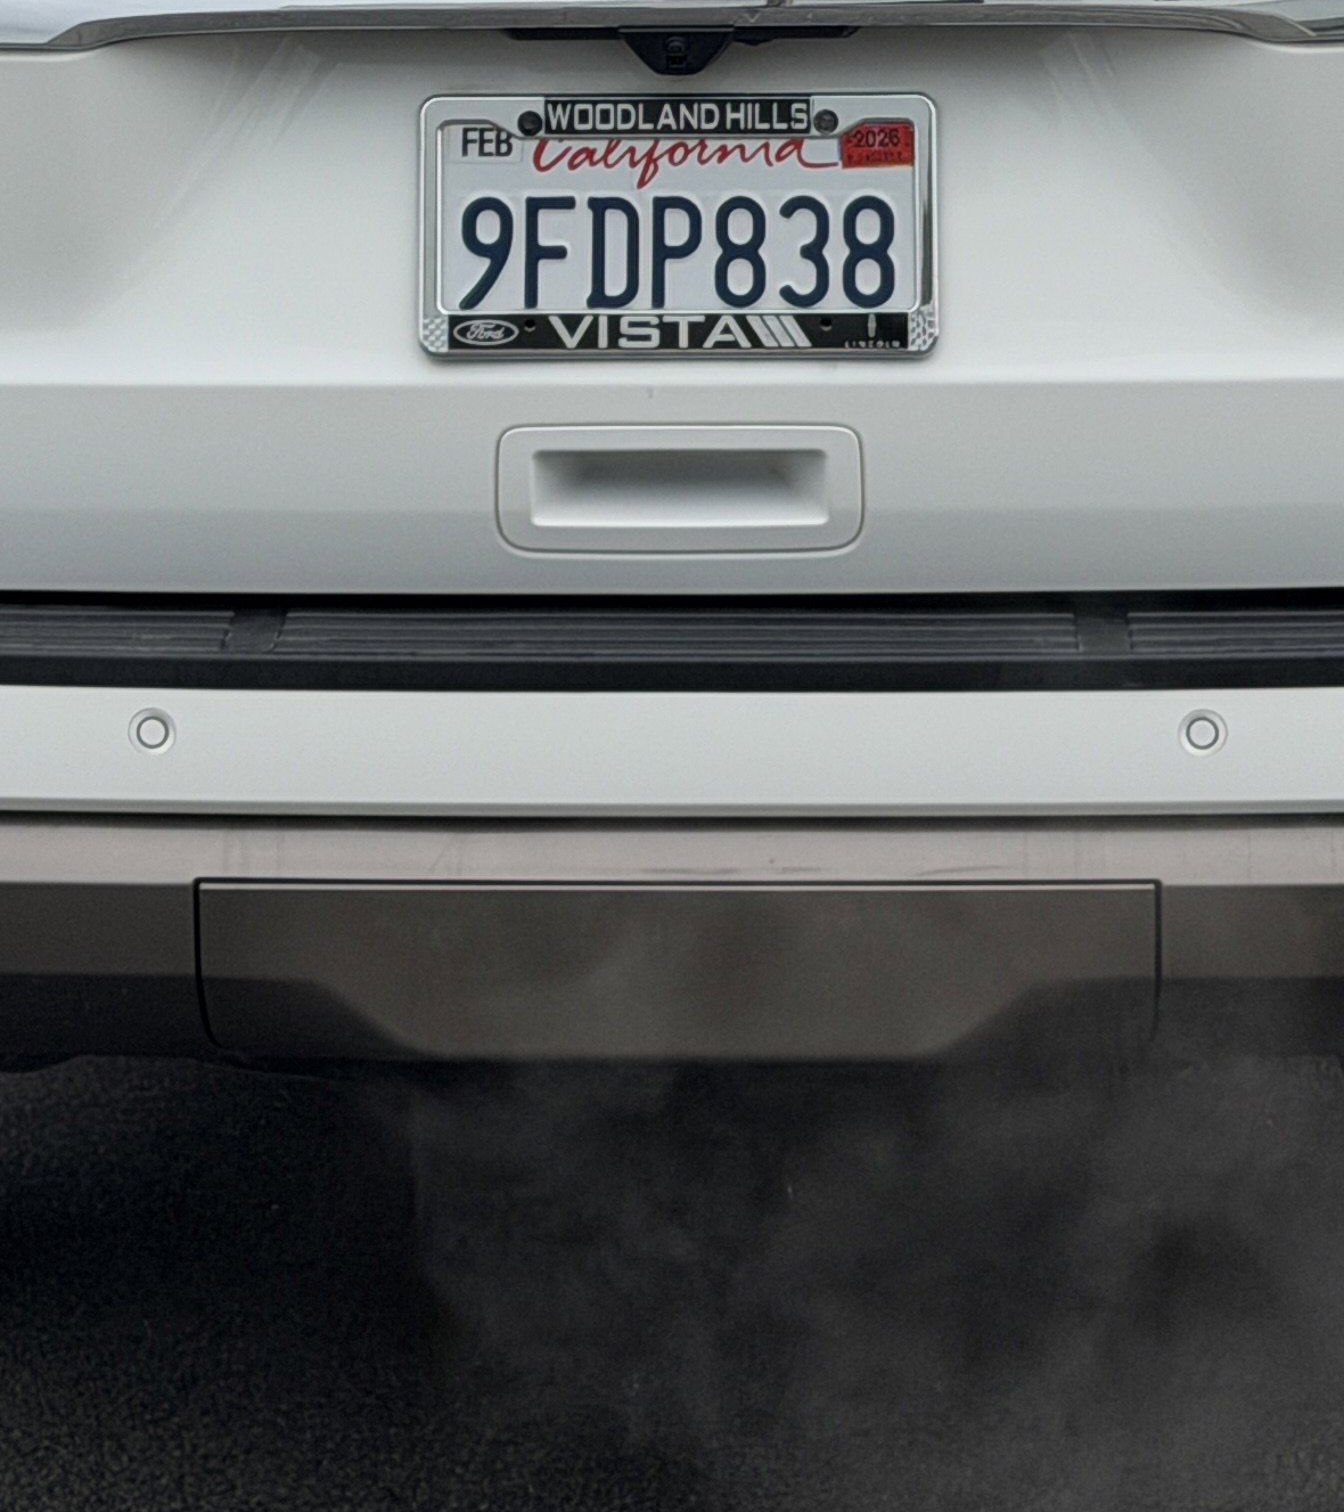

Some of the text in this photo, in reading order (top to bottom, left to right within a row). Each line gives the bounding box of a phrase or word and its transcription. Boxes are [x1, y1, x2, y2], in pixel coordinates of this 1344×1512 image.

[546, 102, 809, 131] WOODLAND HILLS
[461, 126, 513, 157] FEB
[853, 128, 901, 148] 2026
[459, 195, 896, 310] 9FDP838
[465, 323, 505, 341] Ford
[548, 314, 753, 349] VISTA
